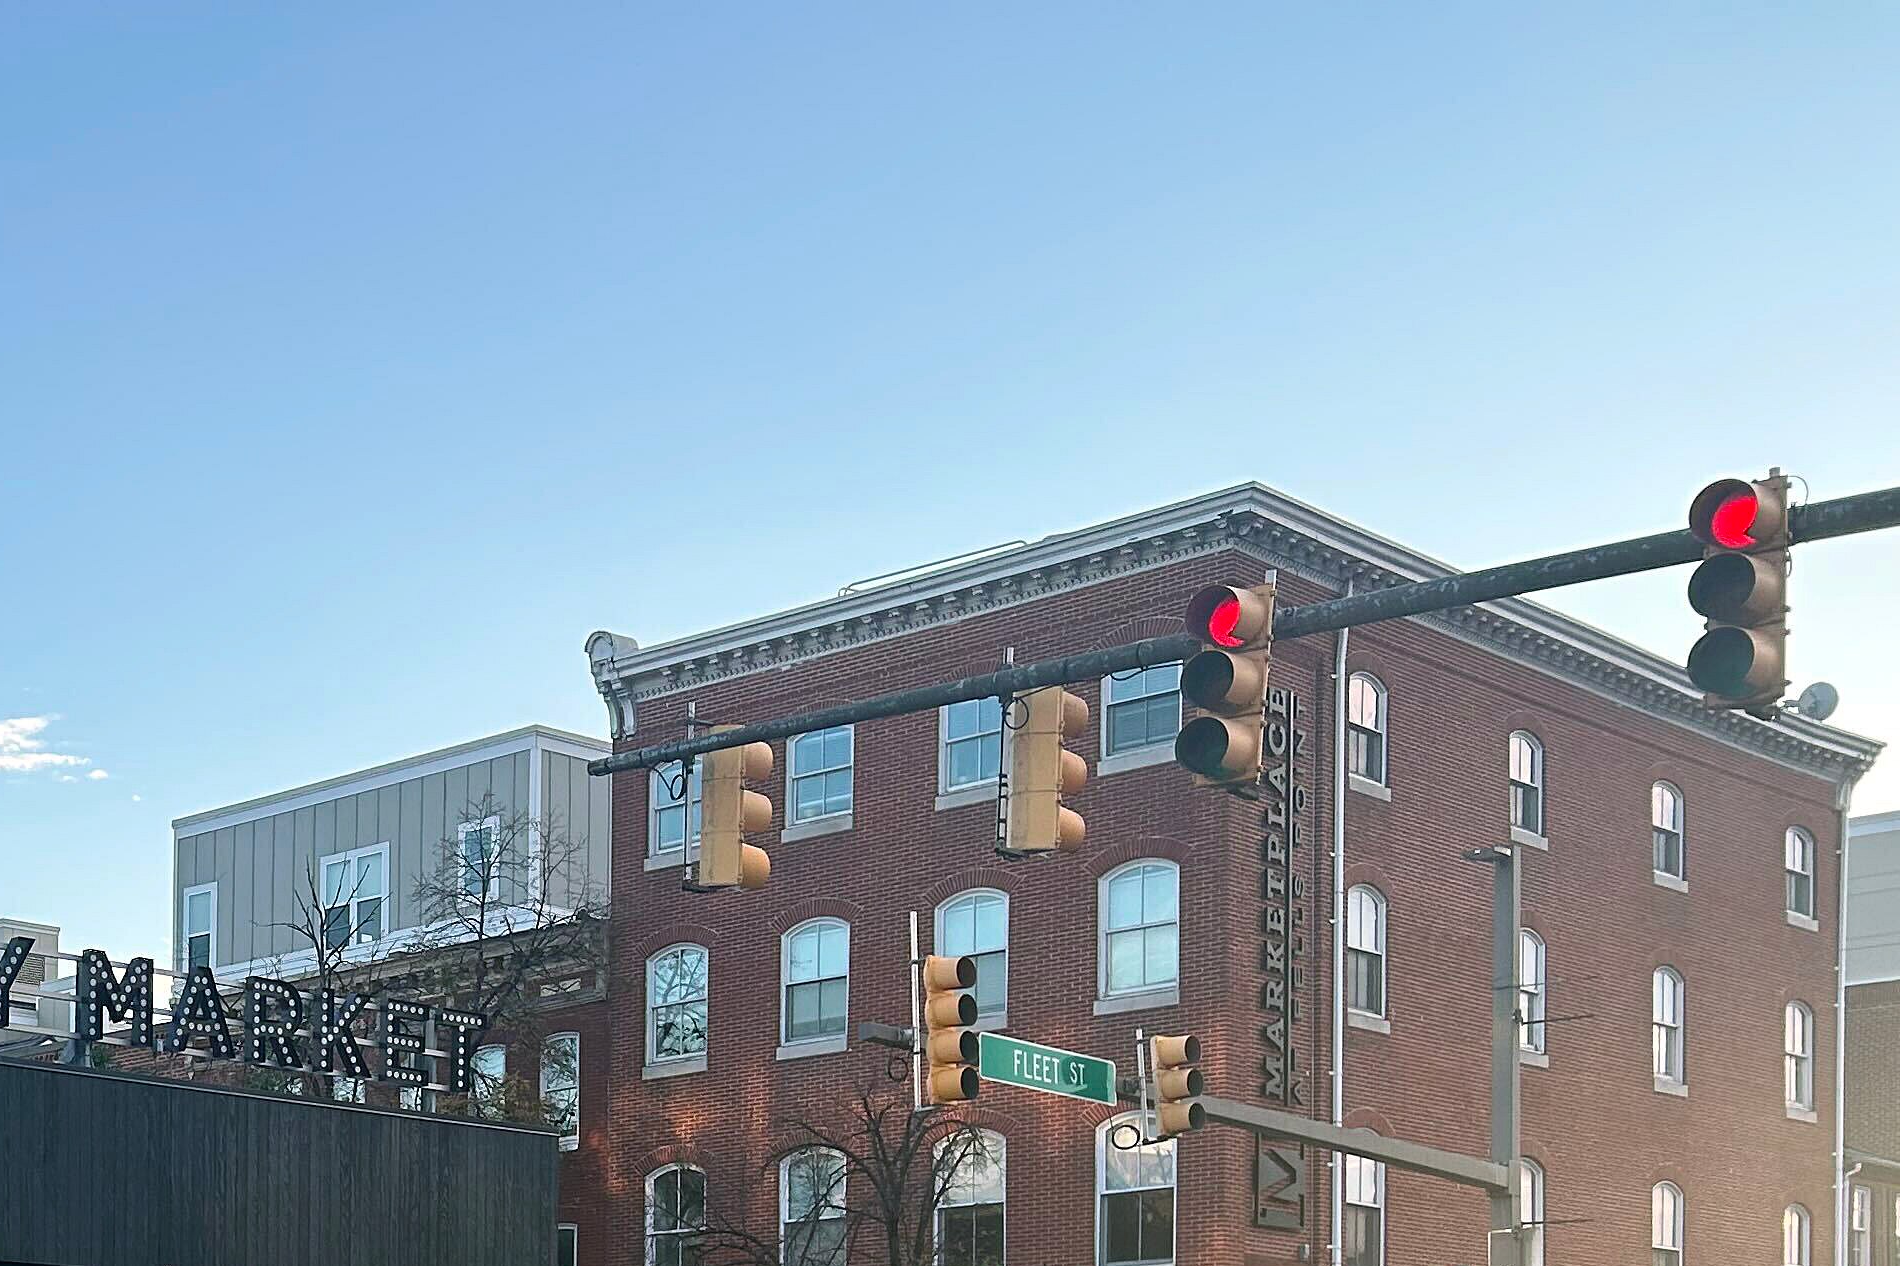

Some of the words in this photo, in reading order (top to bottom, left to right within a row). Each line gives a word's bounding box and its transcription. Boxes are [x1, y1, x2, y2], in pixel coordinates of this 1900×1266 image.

[1264, 687, 1287, 1100] MARKETPLACE
[76, 949, 489, 1093] MARKET
[1013, 1049, 1060, 1084] FLEET
[1069, 1061, 1085, 1086] ST
